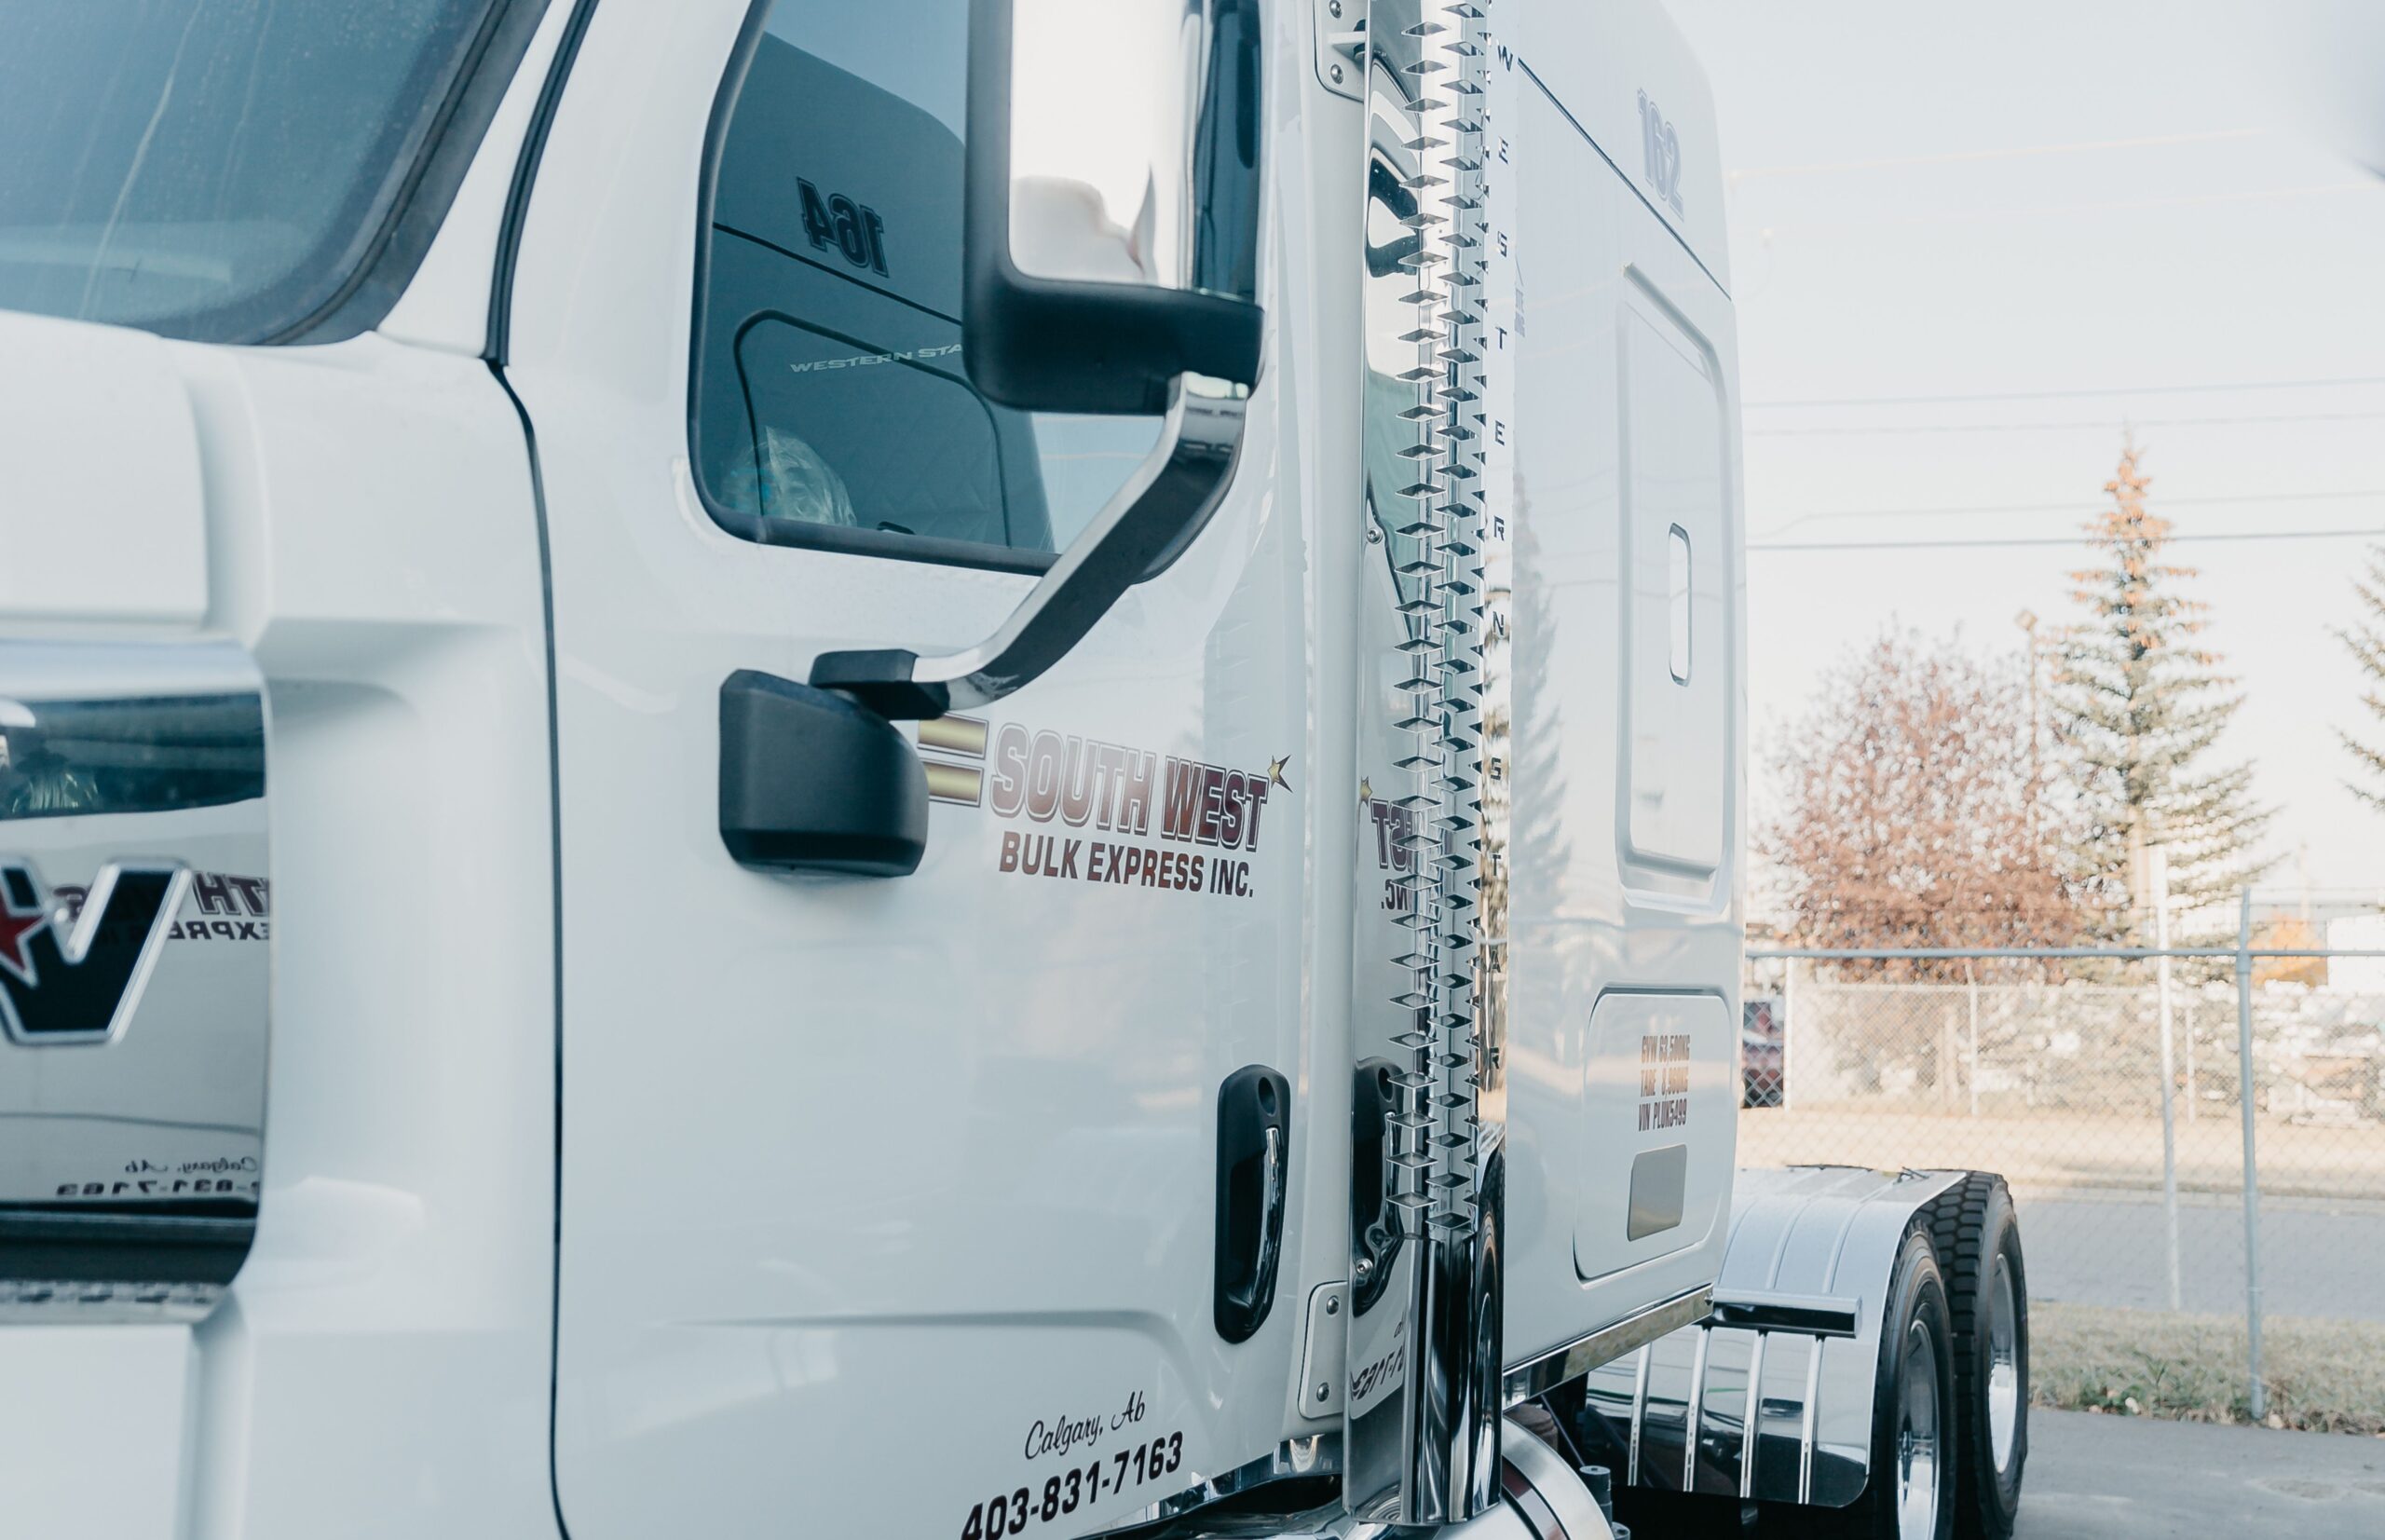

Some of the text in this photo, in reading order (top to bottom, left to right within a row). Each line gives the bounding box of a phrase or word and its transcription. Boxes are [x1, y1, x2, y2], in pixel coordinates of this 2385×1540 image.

[1637, 88, 1684, 223] 162
[790, 343, 963, 373] WESTERN STA
[989, 722, 1268, 852] SOUTH WEST
[999, 831, 1253, 897] BULK EXPRESS INC.
[1639, 1103, 1650, 1131] VIN
[1025, 1390, 1145, 1460] Calgary, Ab
[961, 1431, 1183, 1540] 403-831-7163
